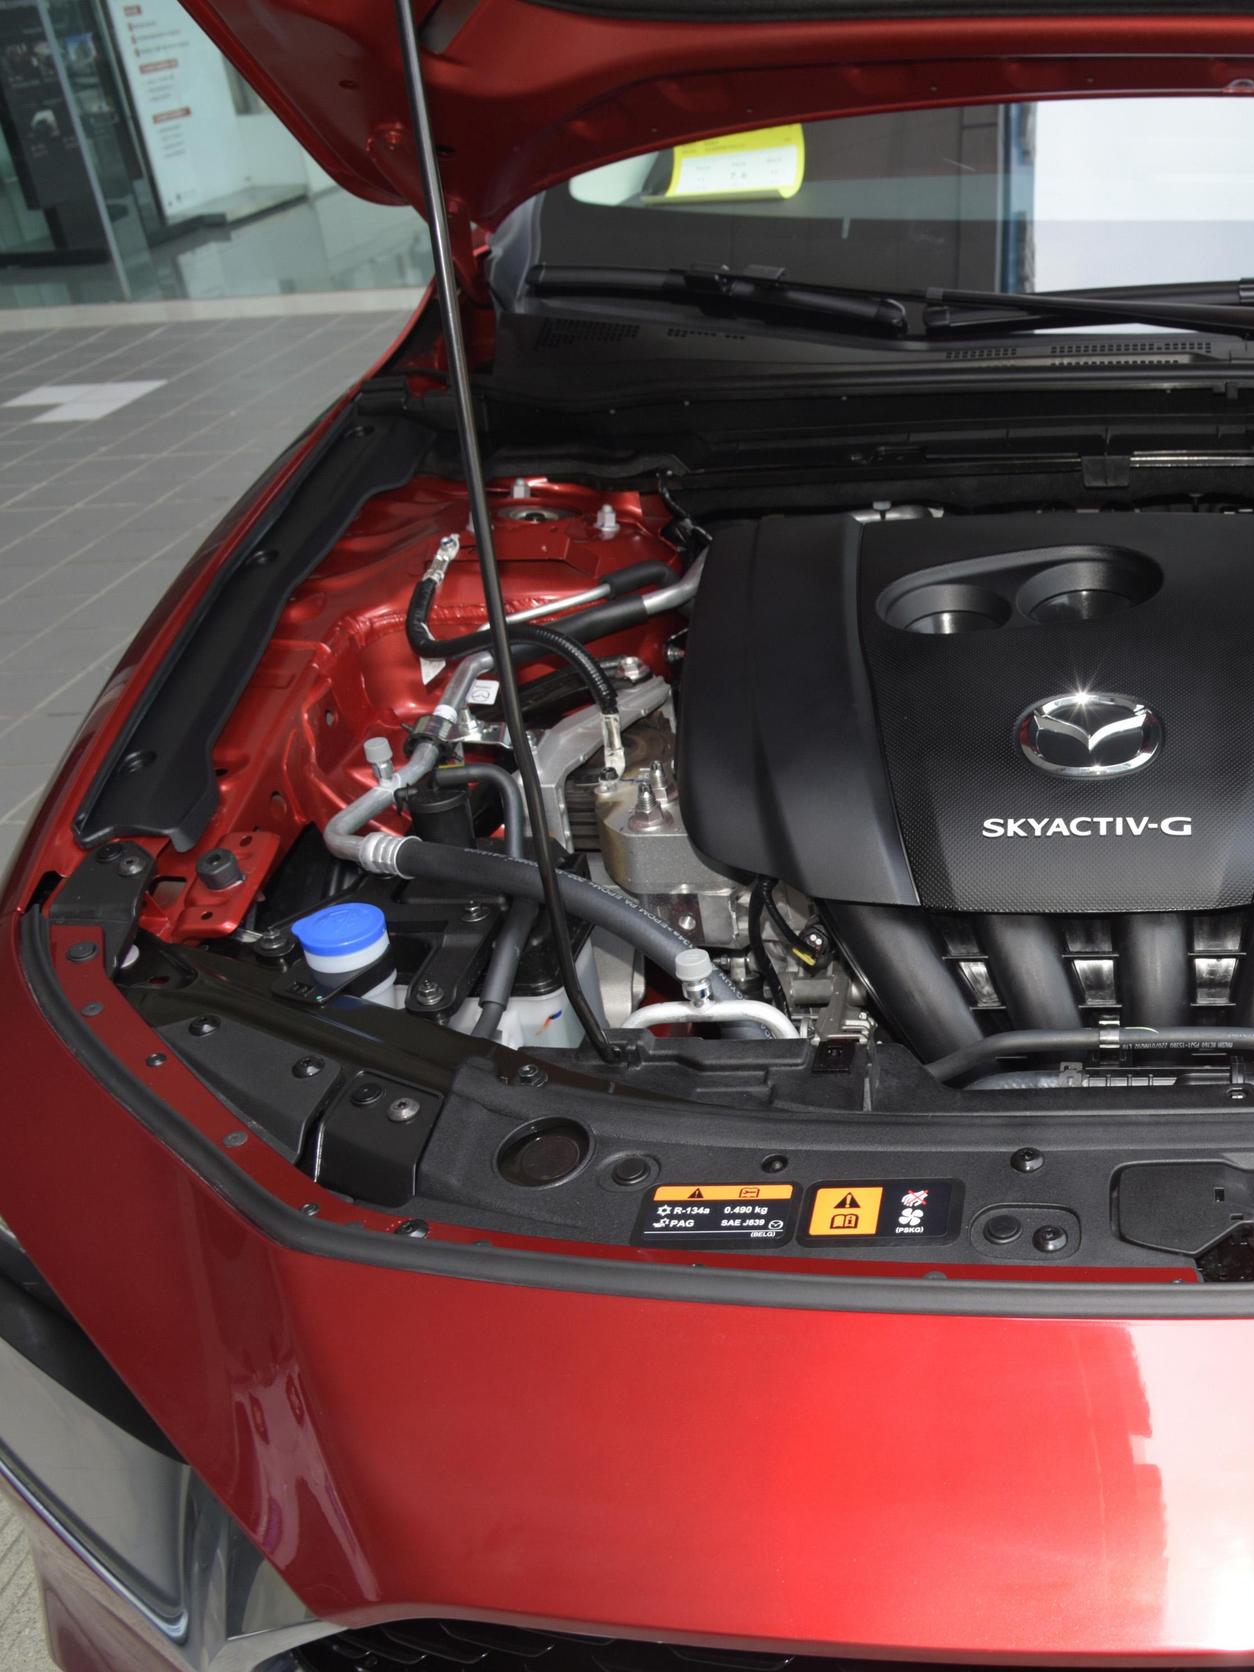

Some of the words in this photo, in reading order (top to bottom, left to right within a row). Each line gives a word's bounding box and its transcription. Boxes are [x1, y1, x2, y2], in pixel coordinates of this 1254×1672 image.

[982, 816, 1193, 838] SKYACTIV-G
[673, 1206, 710, 1215] R-134a
[724, 1206, 753, 1214] 0.490
[754, 1205, 769, 1215] kg
[669, 1219, 695, 1228] PAG
[721, 1219, 742, 1227] SAE
[742, 1219, 766, 1227] J639
